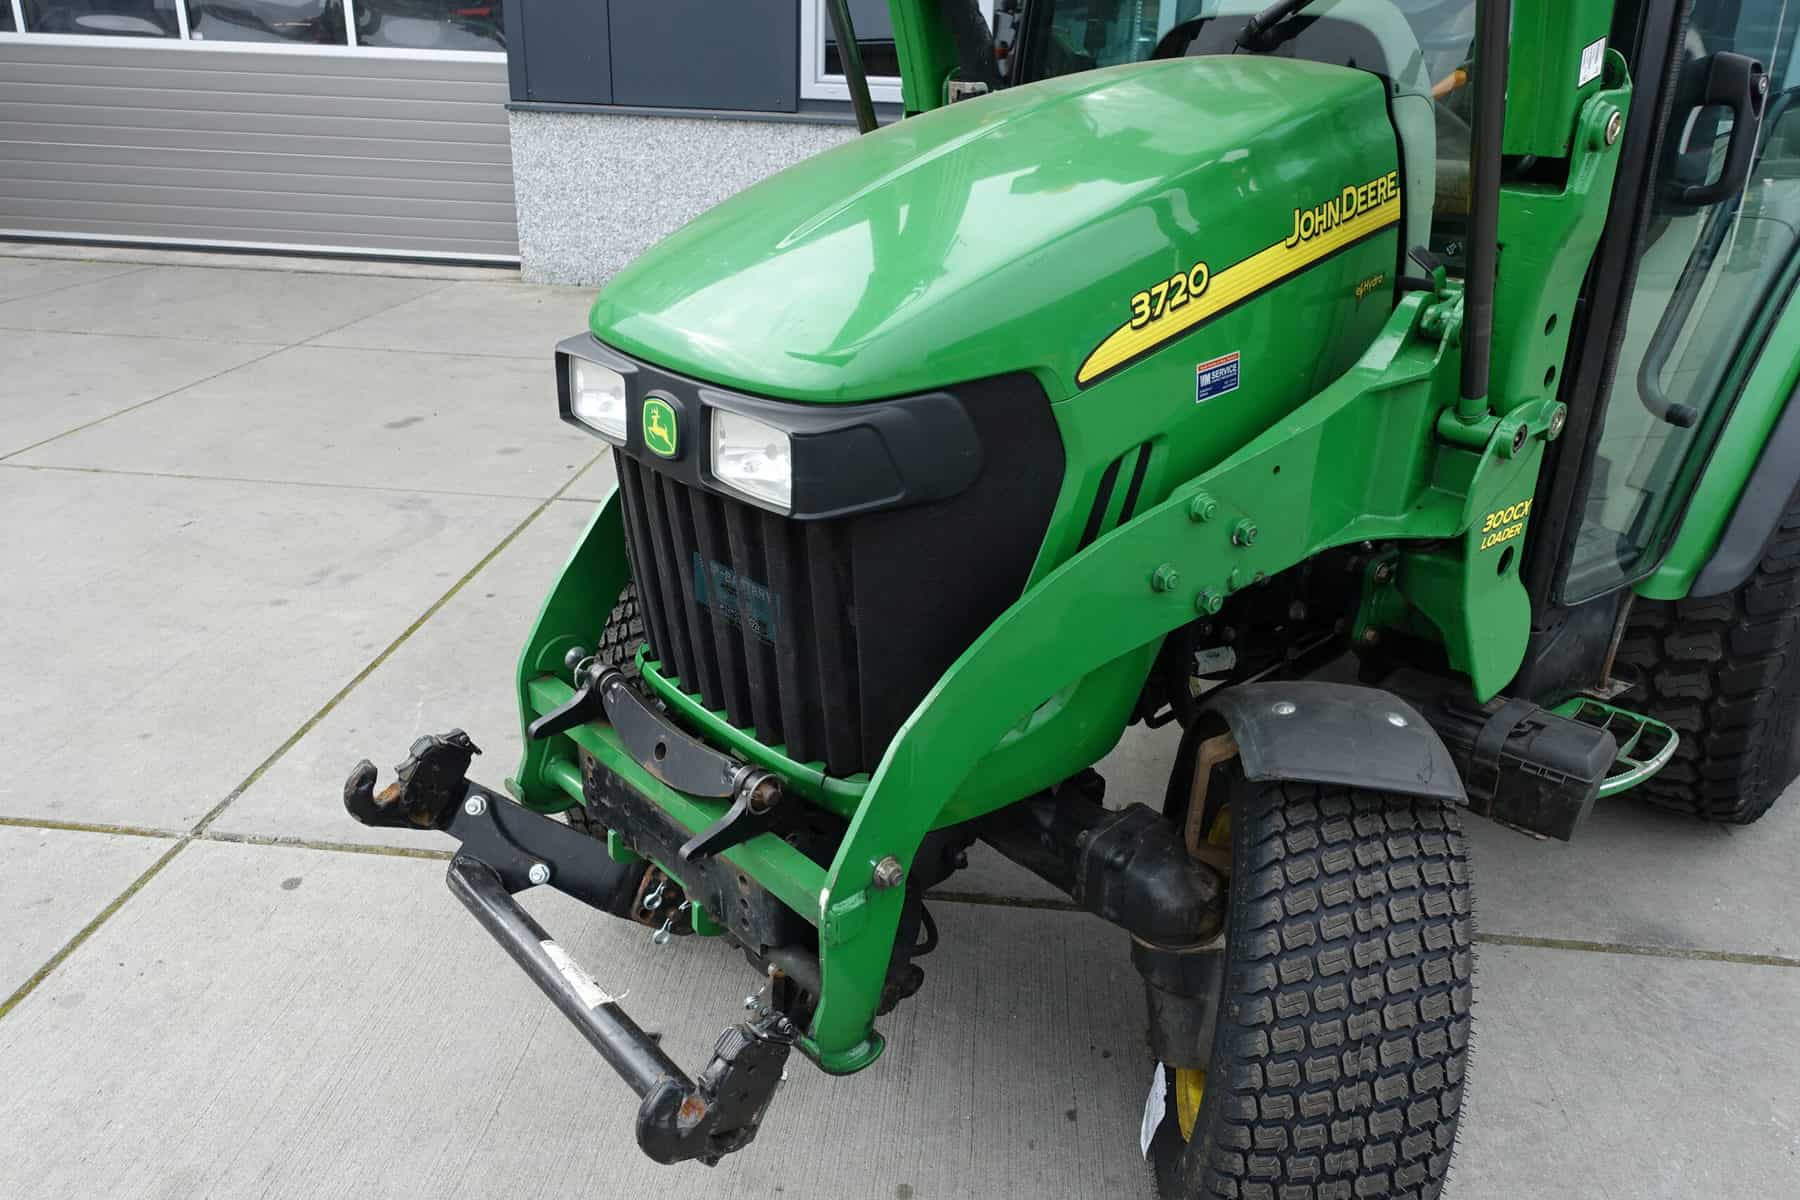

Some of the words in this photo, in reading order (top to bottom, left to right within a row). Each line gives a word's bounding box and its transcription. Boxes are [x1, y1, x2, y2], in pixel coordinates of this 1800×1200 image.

[1285, 197, 1341, 248] JOHN
[1341, 170, 1399, 222] DEERE
[1130, 261, 1210, 329] 3720
[1211, 362, 1237, 379] SERVICE
[1482, 497, 1534, 533] 300CX
[1480, 522, 1523, 551] LOADER
